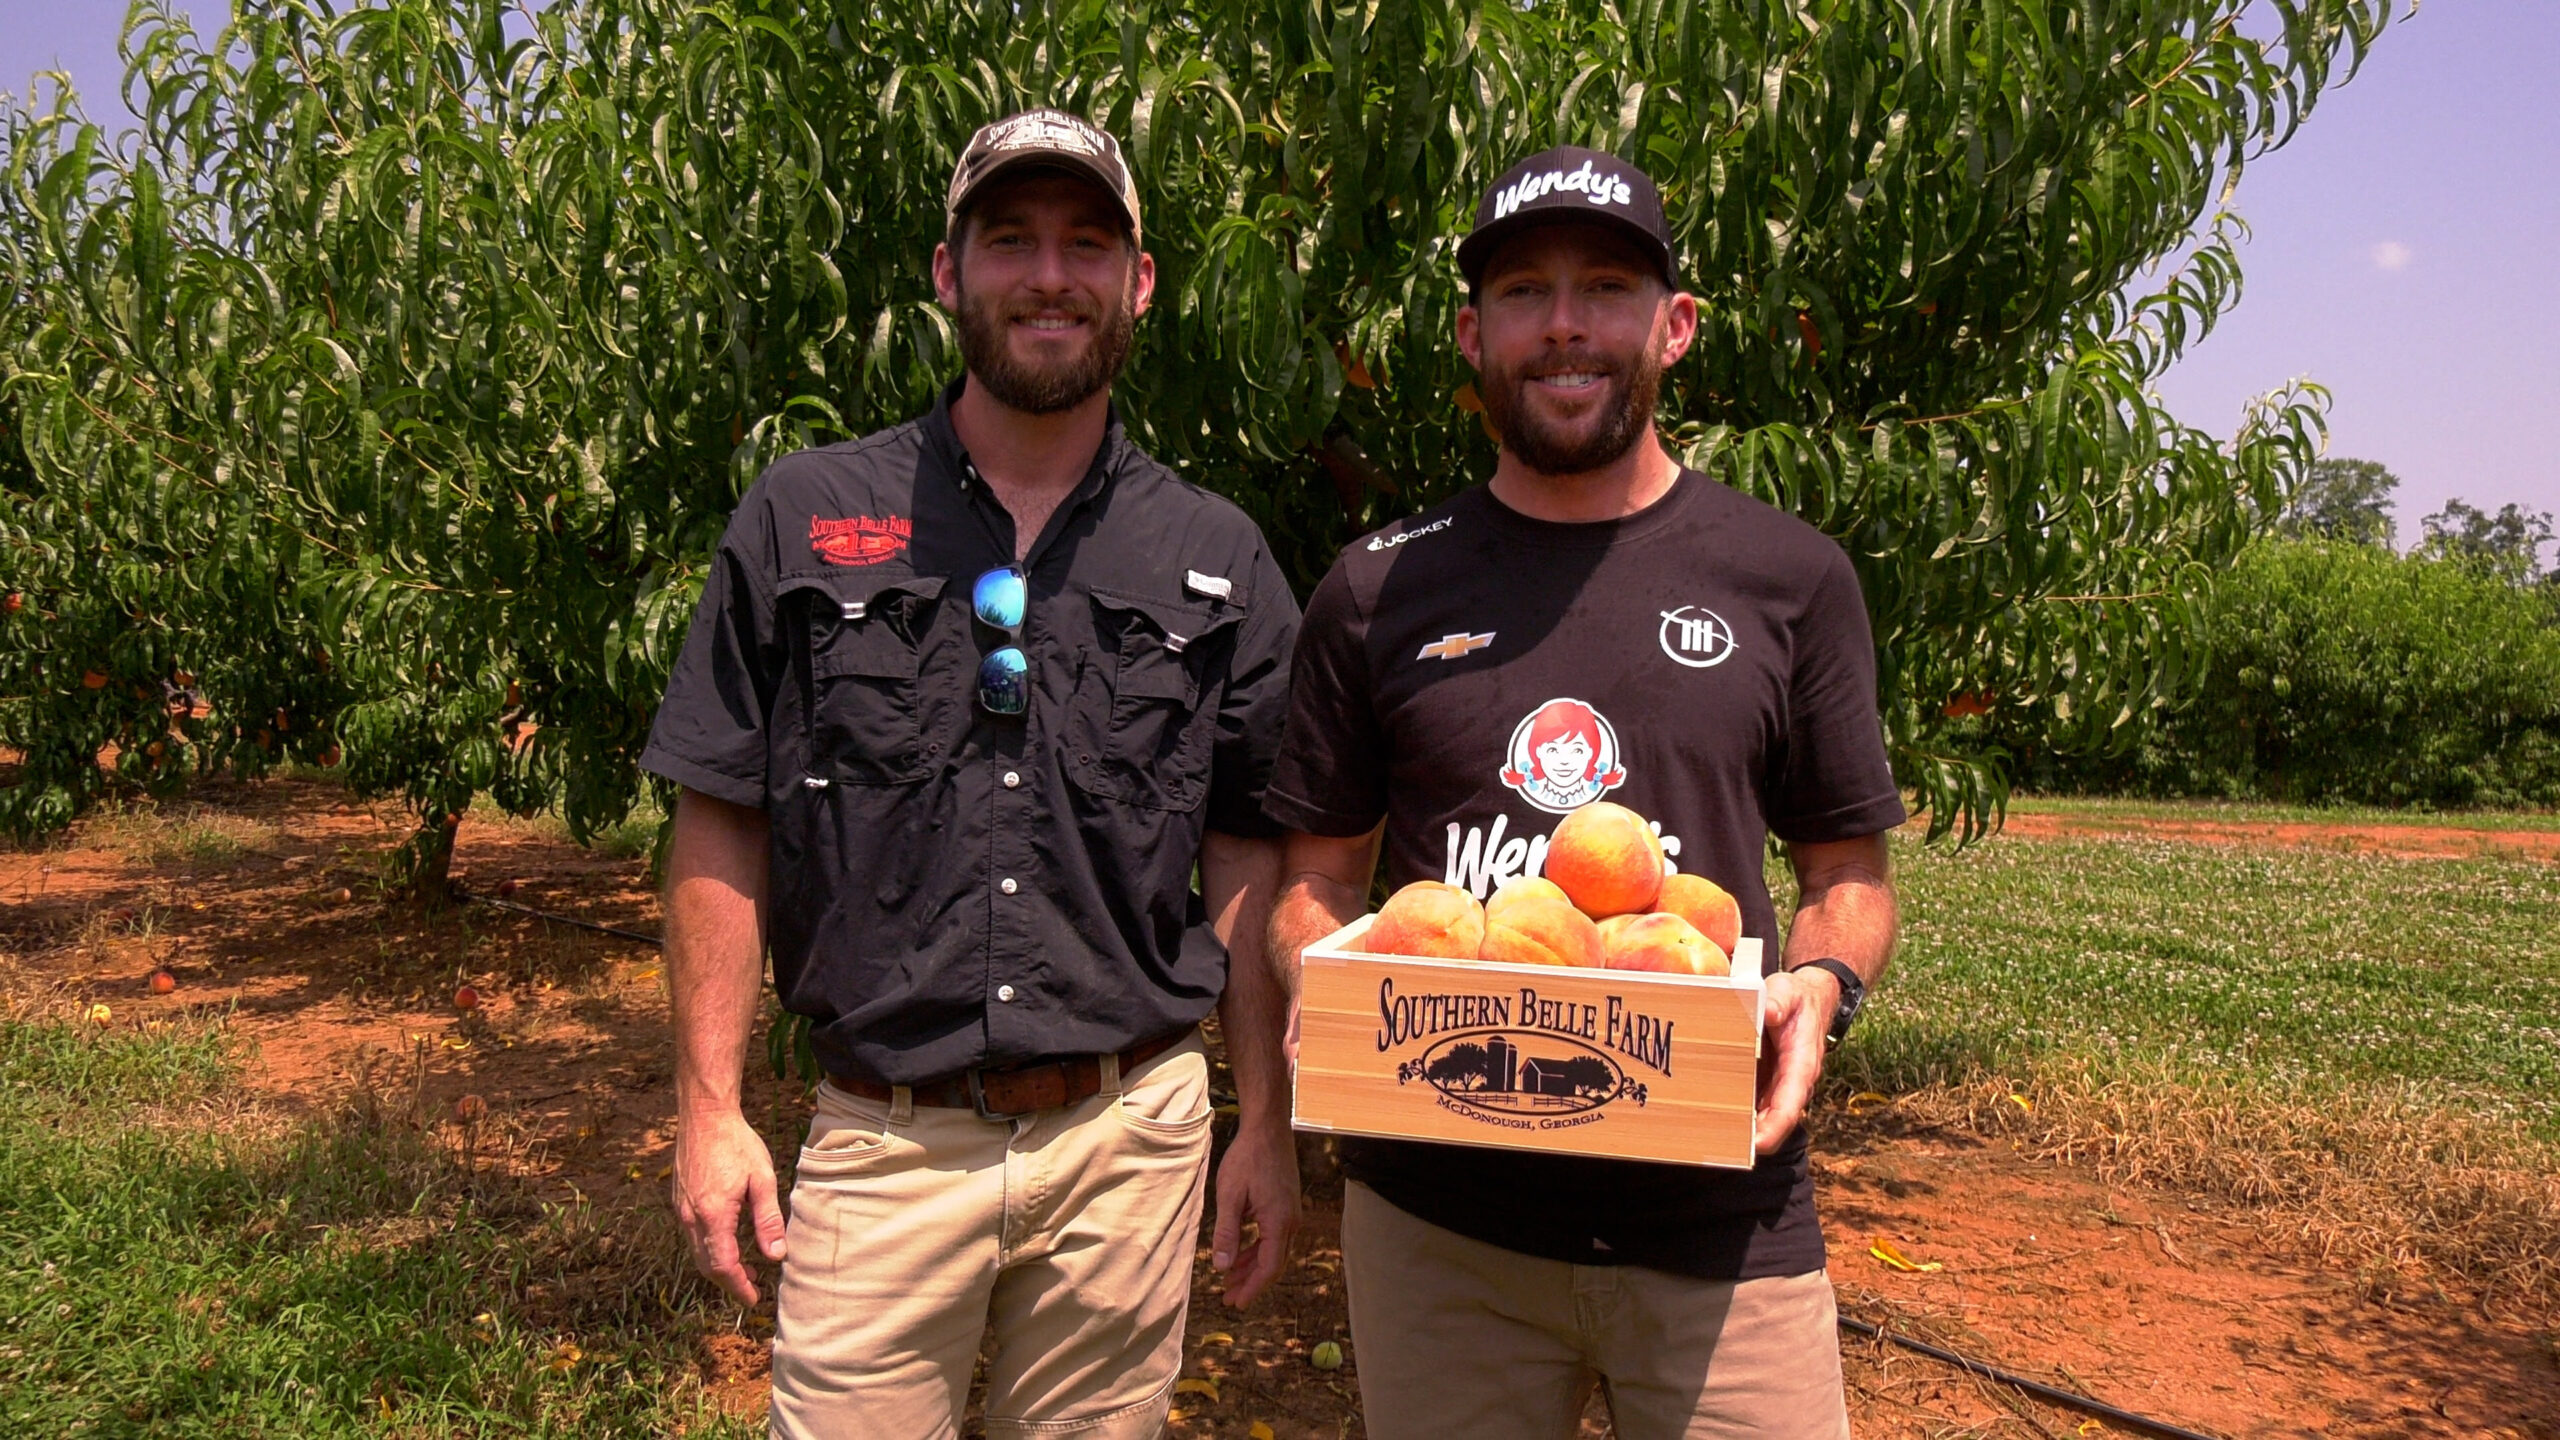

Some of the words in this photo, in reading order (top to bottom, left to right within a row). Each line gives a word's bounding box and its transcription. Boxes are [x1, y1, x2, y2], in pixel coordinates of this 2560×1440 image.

[1077, 121, 1105, 152] FARM
[1494, 160, 1631, 219] Wendy's
[809, 514, 859, 539] SOUTHERN
[860, 515, 888, 531] BELLE
[889, 515, 912, 538] FARM
[1384, 516, 1453, 548] JOCKEY
[1444, 813, 1682, 900] Wen's
[1376, 977, 1511, 1053] SOUTHERN
[1518, 988, 1597, 1041] BELLE
[1603, 995, 1674, 1078] FARM
[1540, 1112, 1605, 1130] GEORGIA
